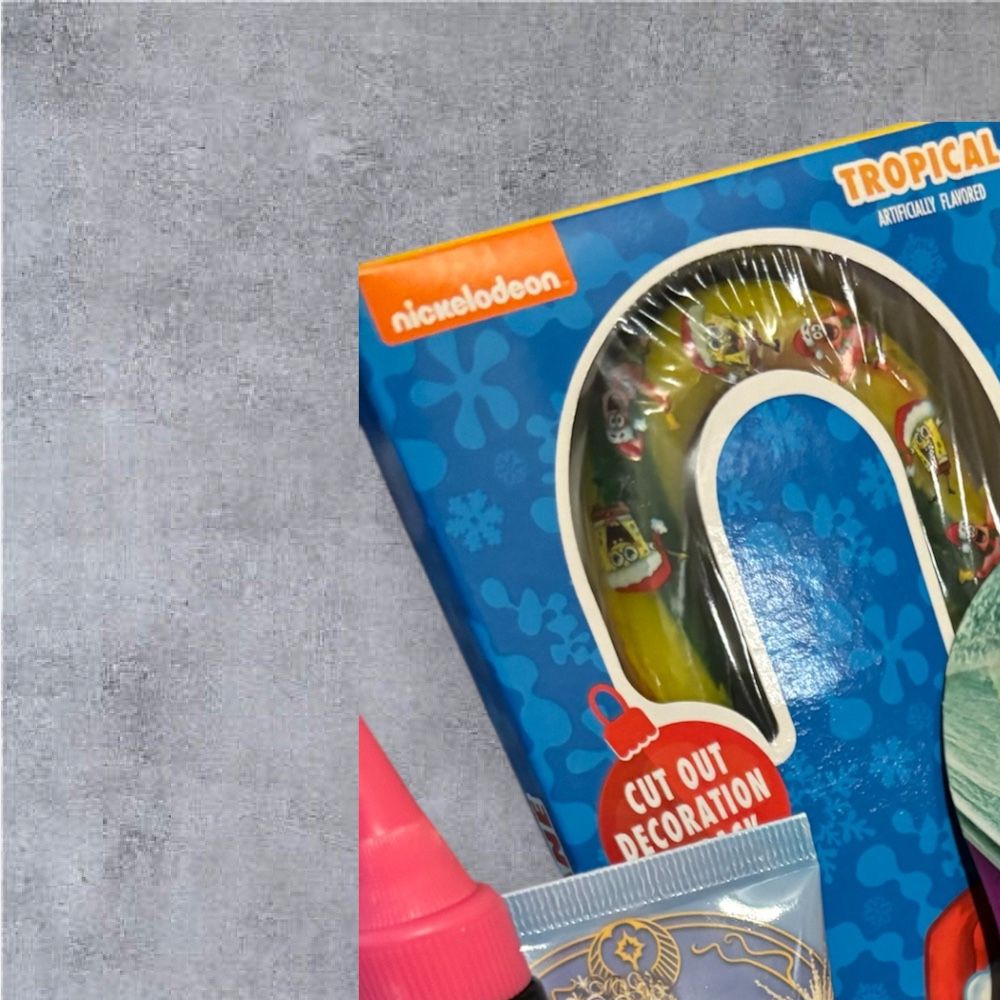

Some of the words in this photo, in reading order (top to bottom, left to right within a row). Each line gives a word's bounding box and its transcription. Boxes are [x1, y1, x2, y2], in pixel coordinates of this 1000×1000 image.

[877, 196, 937, 227] ARTIFICIALLY
[939, 183, 987, 211] FLAVORED
[391, 270, 562, 334] nickelodeon
[623, 767, 675, 815] CUT
[676, 741, 729, 791] OUT
[613, 767, 772, 862] DECORATION
